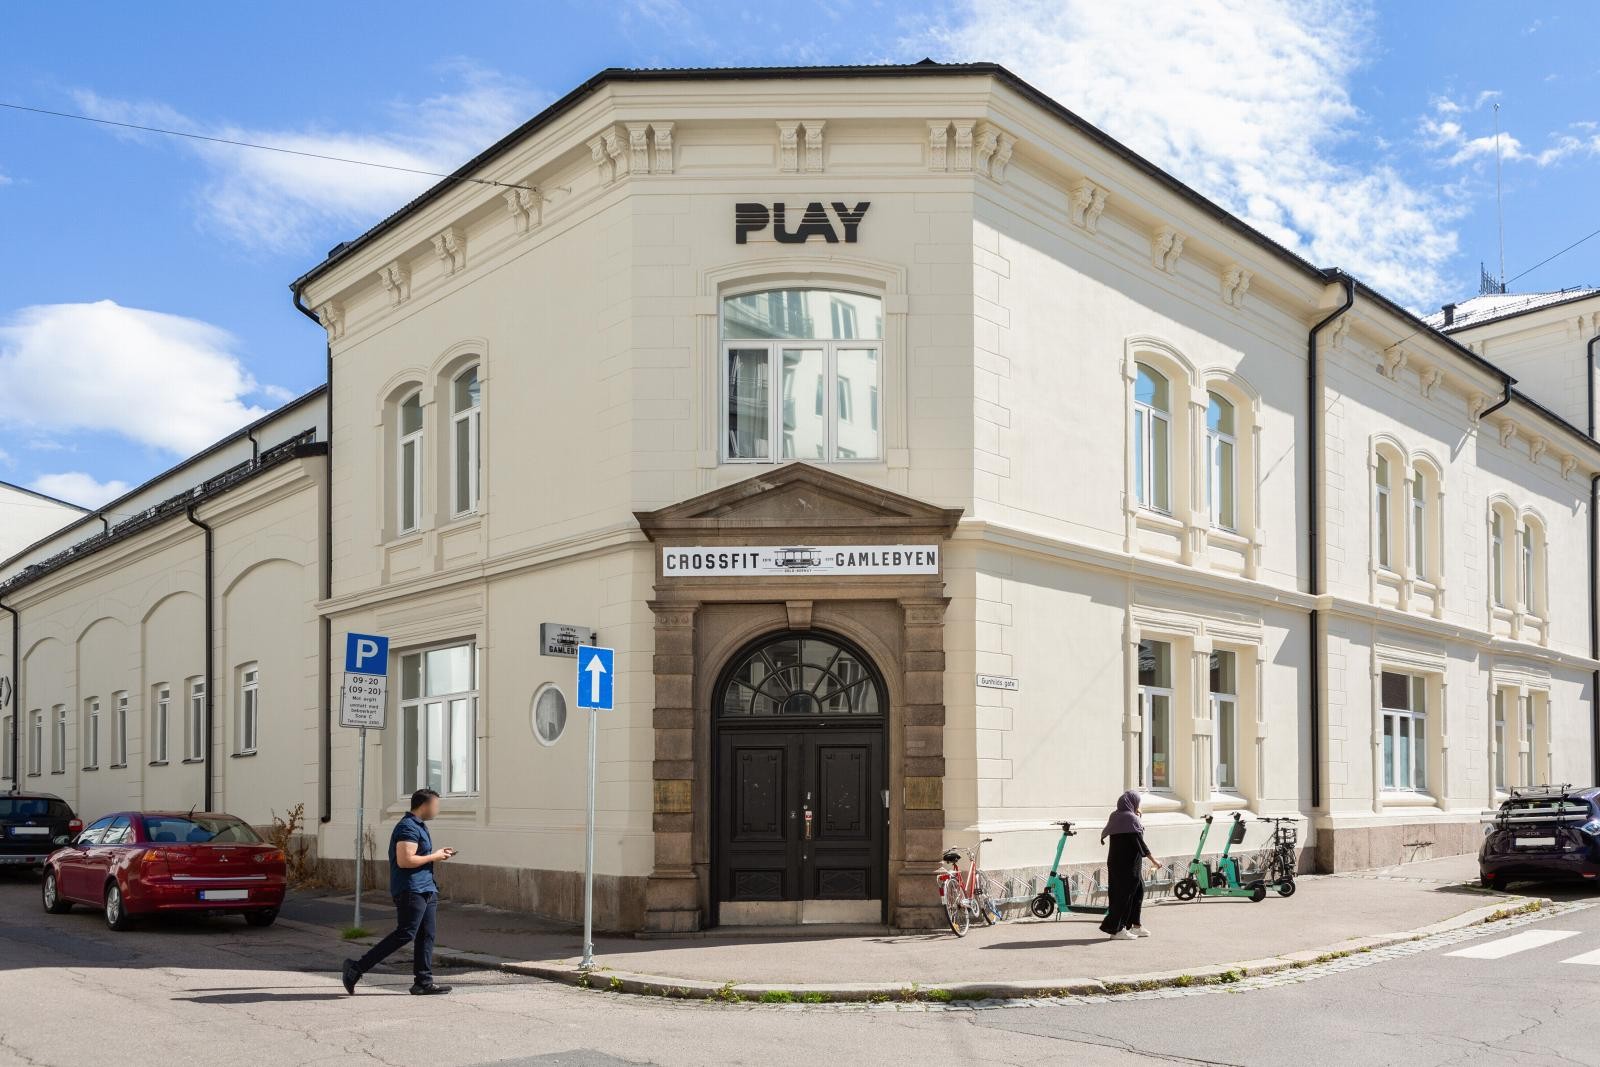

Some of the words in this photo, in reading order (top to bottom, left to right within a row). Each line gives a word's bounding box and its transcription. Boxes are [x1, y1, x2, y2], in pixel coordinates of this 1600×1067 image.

[736, 202, 871, 244] PLAY
[666, 553, 759, 570] CROSSFIT
[835, 551, 936, 567] GAMLEBYEN
[356, 639, 379, 668] P
[548, 645, 578, 655] GAMLEBY
